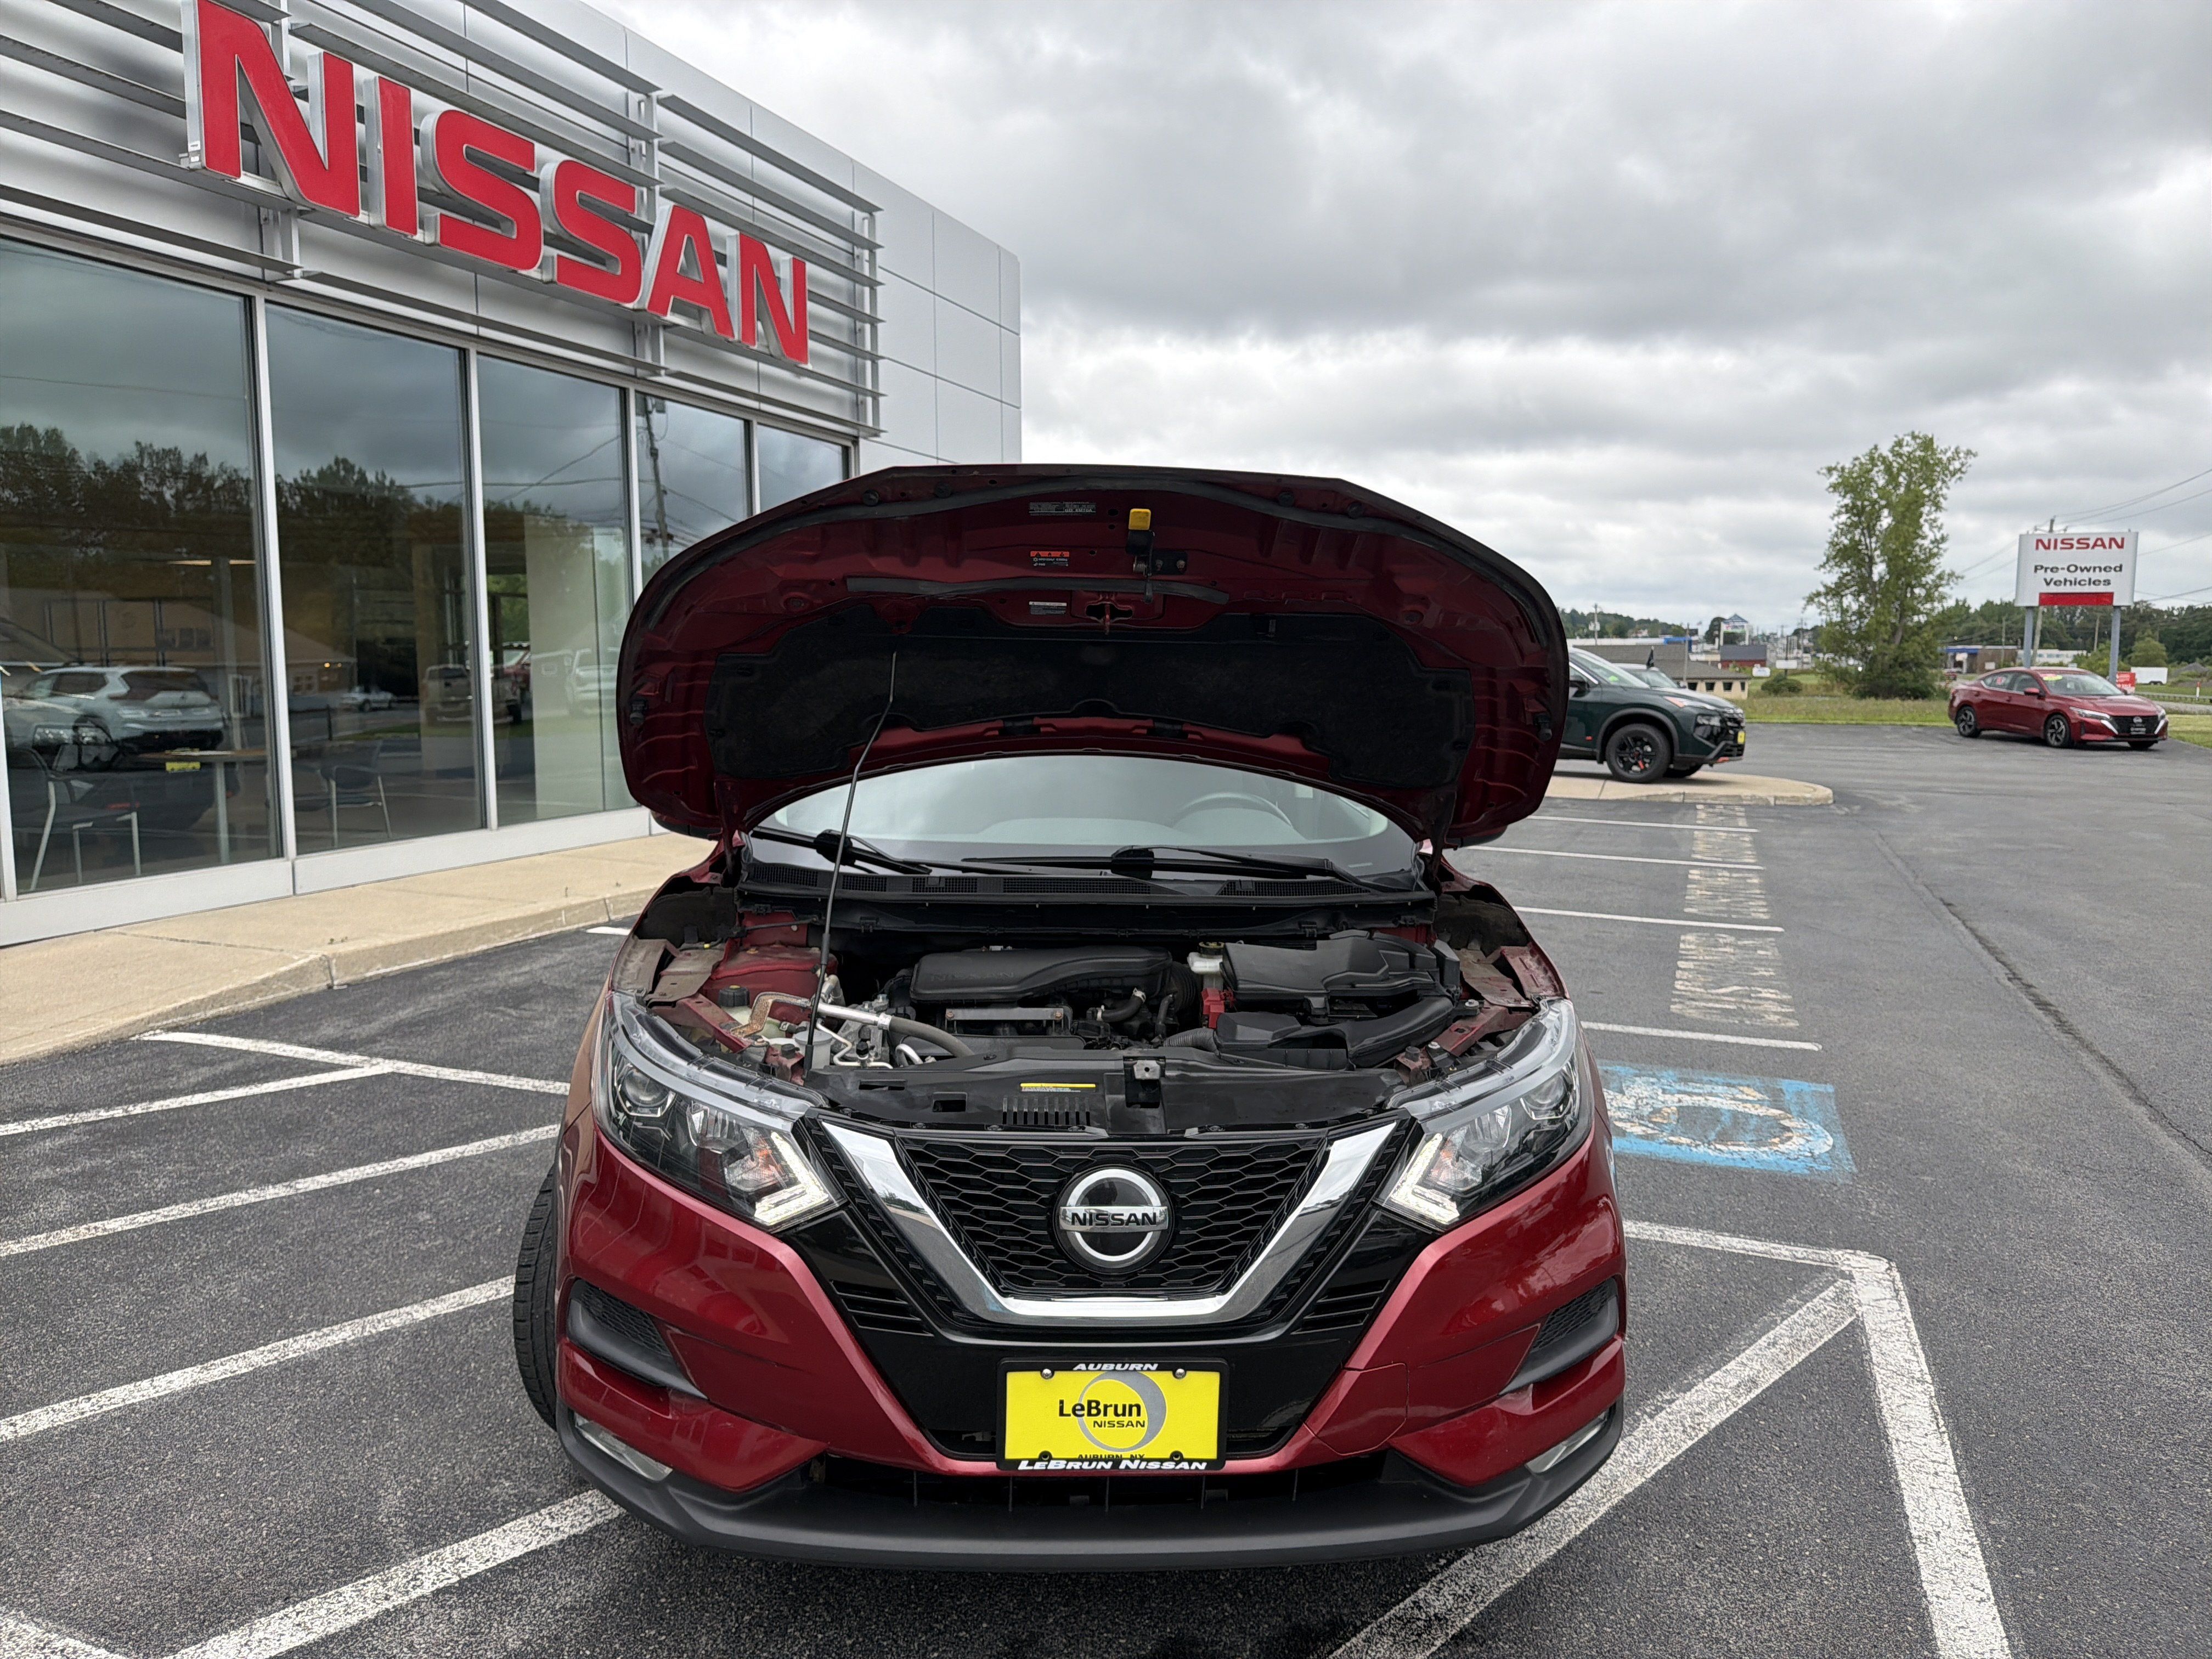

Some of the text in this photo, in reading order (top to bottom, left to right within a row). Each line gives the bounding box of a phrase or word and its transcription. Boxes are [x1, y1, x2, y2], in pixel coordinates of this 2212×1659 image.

[187, 0, 809, 365] NISSAN
[2035, 537, 2125, 550] NISSAN
[2034, 563, 2123, 573] Pre-Owned
[2044, 577, 2112, 587] Vehicles
[1071, 1211, 1156, 1226] NISSAN
[1058, 1399, 1142, 1417] LeBrun
[1093, 1420, 1146, 1428] NISSAN
